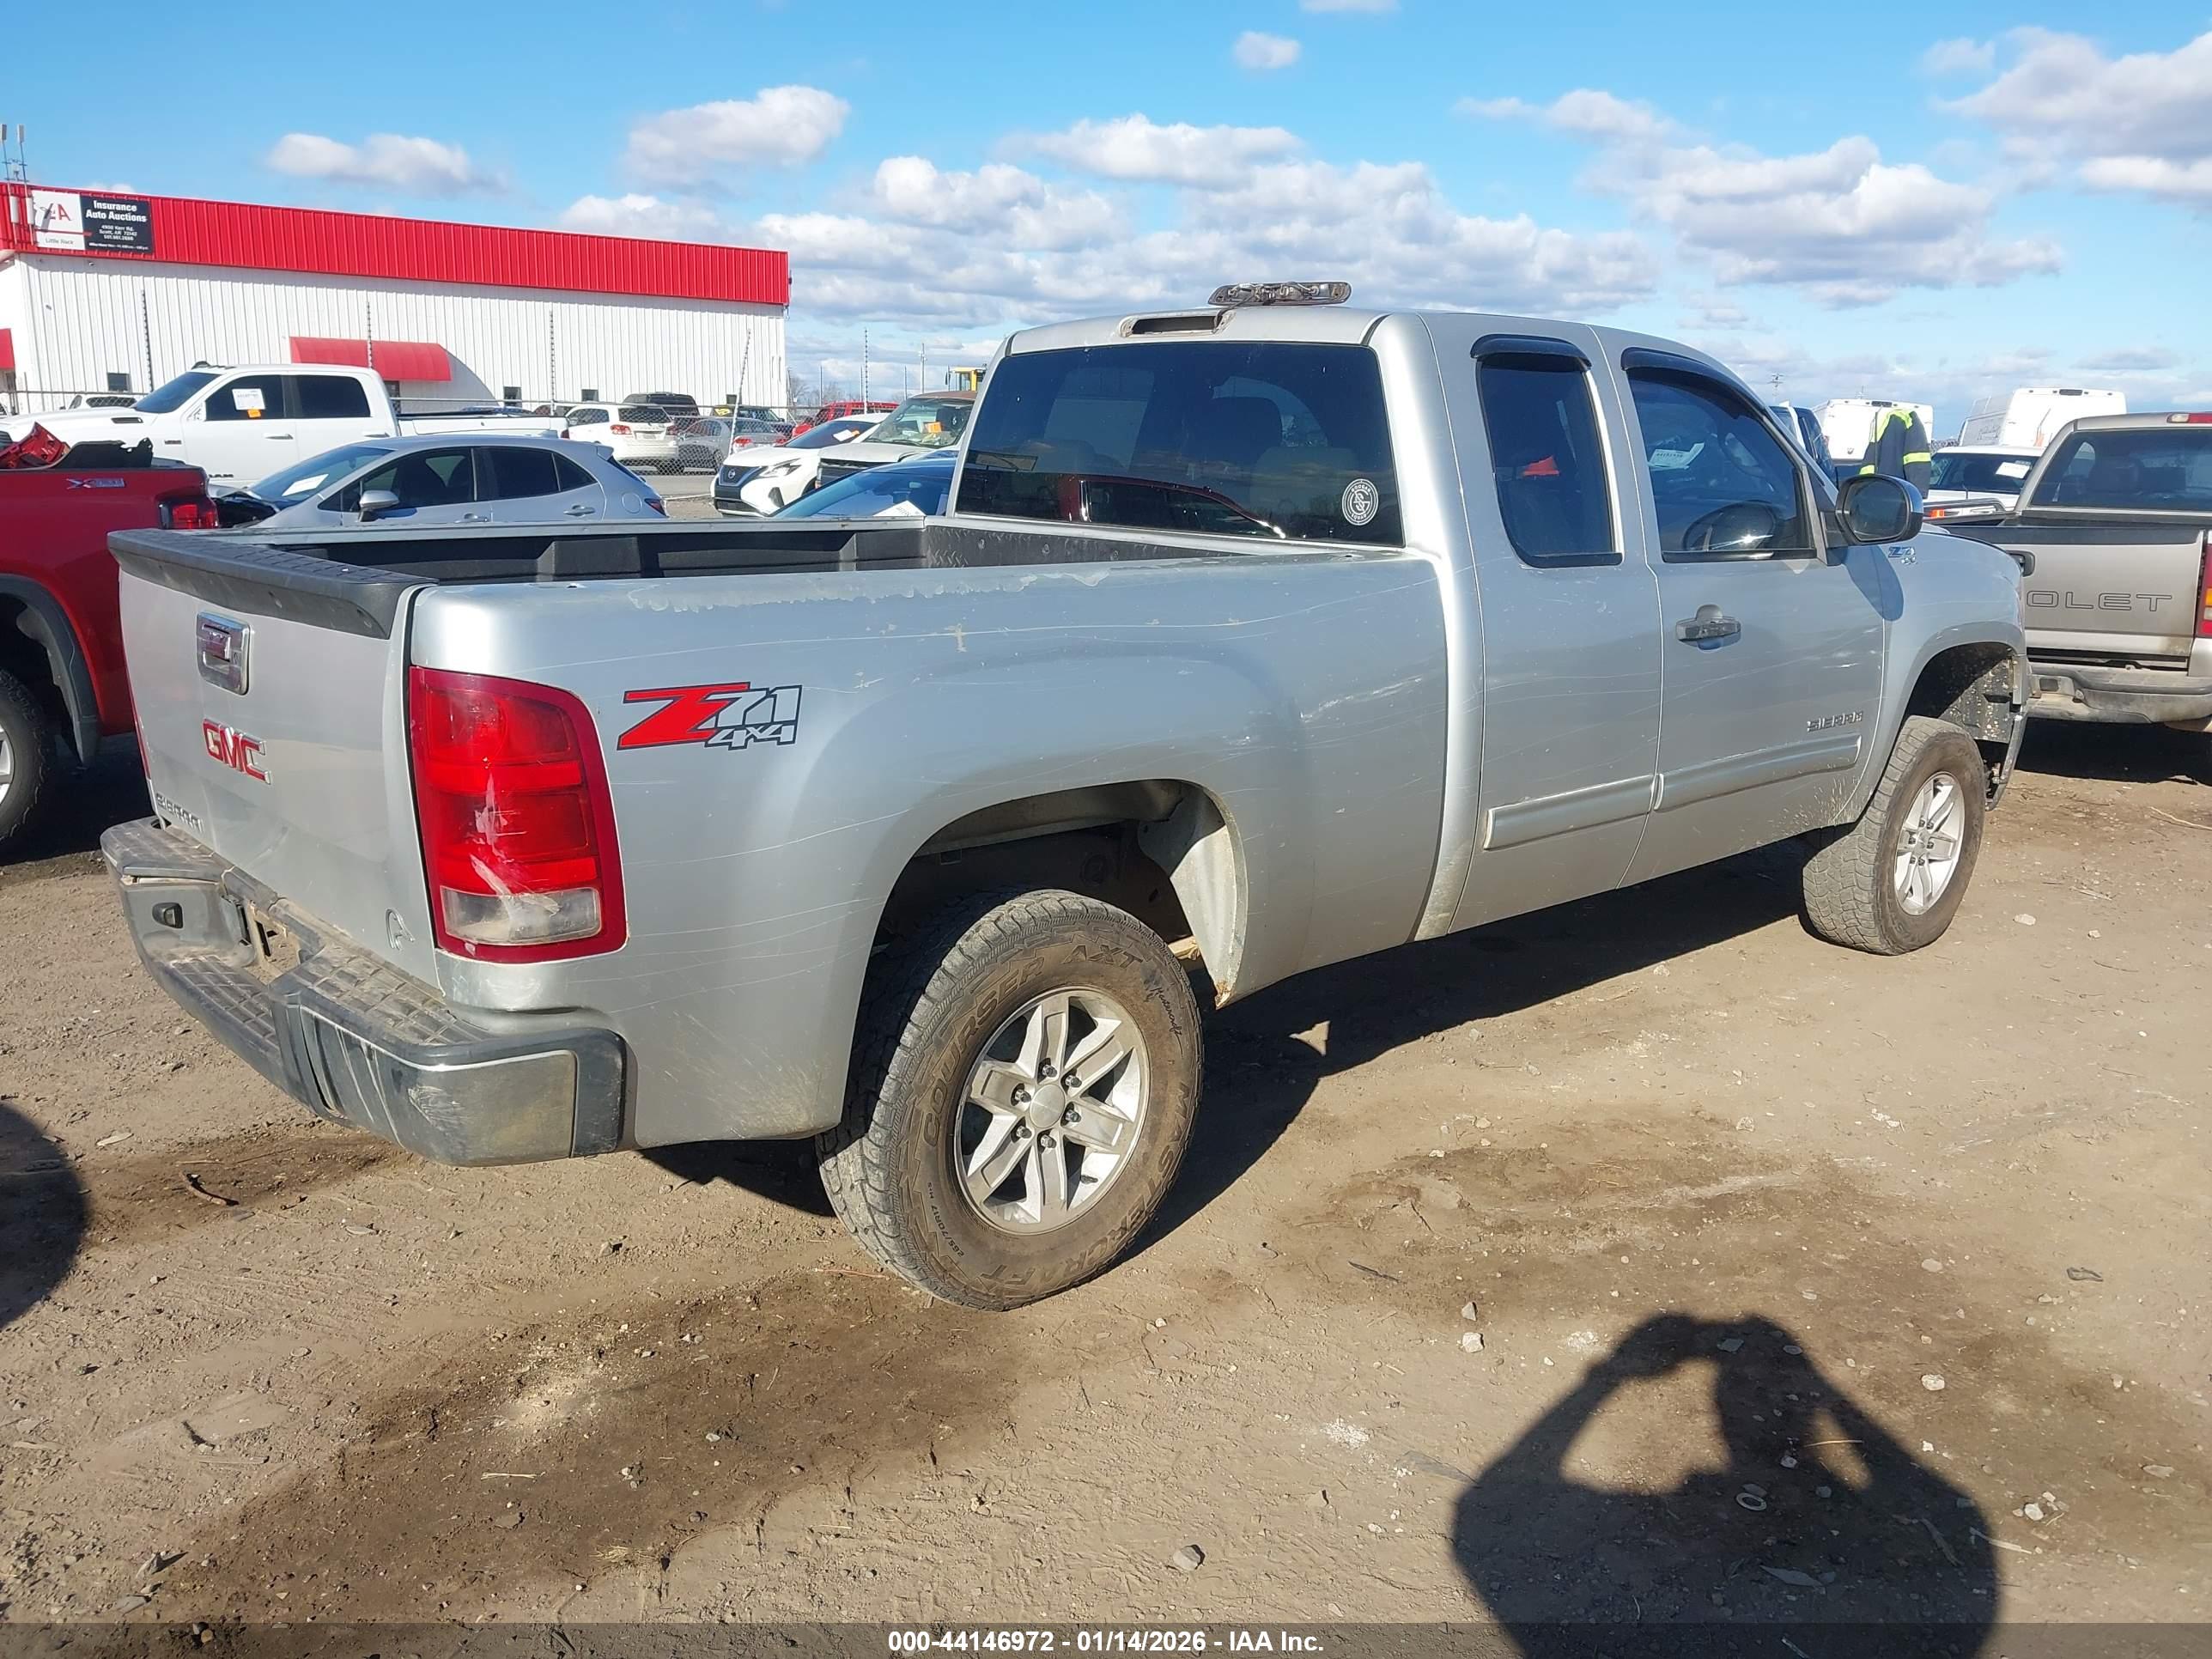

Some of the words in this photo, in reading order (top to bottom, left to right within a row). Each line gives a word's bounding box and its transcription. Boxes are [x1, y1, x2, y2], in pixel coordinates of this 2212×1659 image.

[86, 210, 106, 218] Auto
[108, 211, 147, 222] Auctions
[94, 200, 137, 211] Insurance
[2027, 590, 2172, 612] OLET
[617, 682, 803, 750] Z71
[1806, 709, 1863, 732] SIERRA
[202, 718, 272, 785] GMC
[923, 956, 1045, 1148] COURSER
[1063, 944, 1143, 971] AXT
[931, 1205, 965, 1257] 265/70R17
